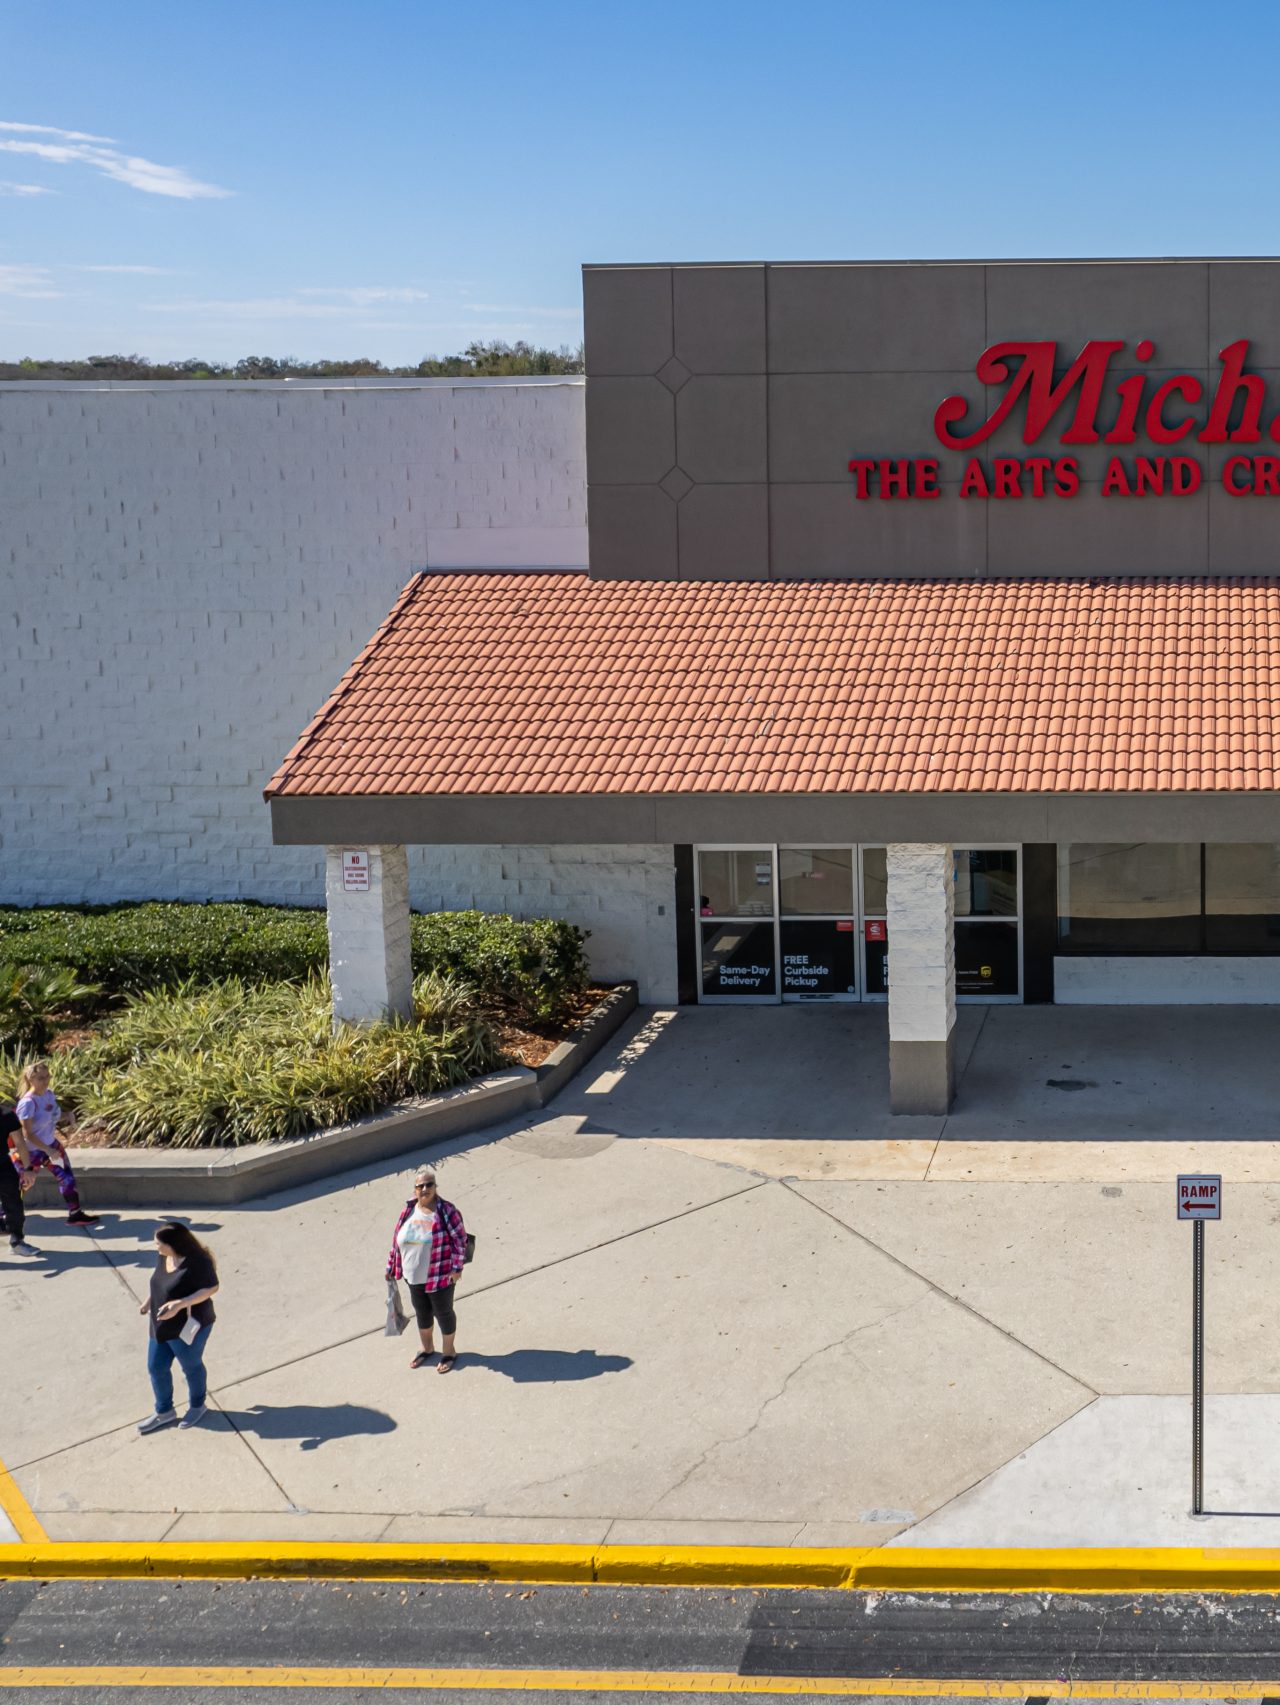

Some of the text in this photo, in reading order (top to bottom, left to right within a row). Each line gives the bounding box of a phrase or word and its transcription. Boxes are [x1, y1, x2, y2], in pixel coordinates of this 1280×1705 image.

[848, 459, 940, 500] THE
[960, 457, 1079, 499] ARTS
[1101, 456, 1201, 497] AND
[351, 855, 360, 864] NO
[784, 955, 809, 964] FREE
[720, 965, 771, 976] Same-Day
[784, 966, 829, 975] Curbside
[720, 976, 760, 987] Delivery
[785, 976, 818, 987] Pickup
[1181, 1185, 1217, 1198] RAMP
